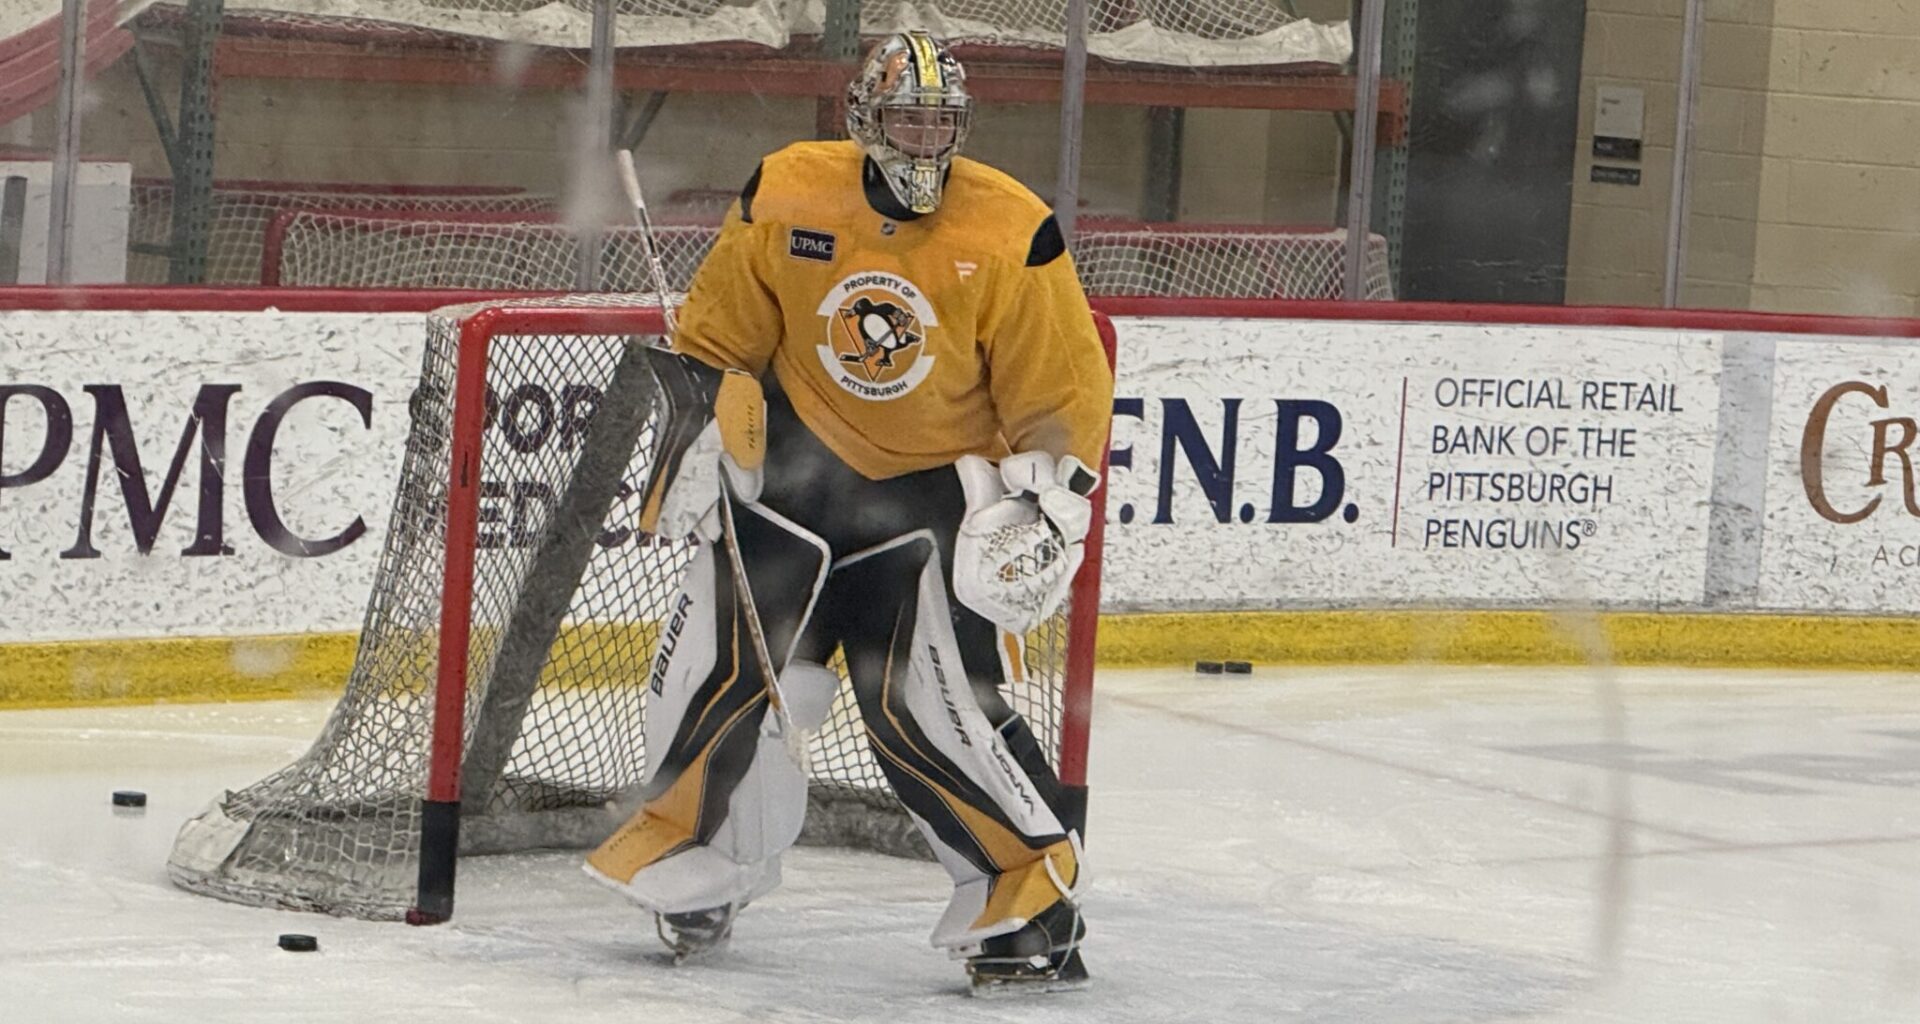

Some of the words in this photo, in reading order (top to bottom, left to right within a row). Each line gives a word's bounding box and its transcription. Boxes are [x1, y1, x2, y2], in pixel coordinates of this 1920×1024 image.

[792, 236, 833, 254] UPMC
[843, 276, 902, 293] PROPERTY
[901, 286, 917, 299] OF
[841, 375, 908, 397] PITTSBURGH
[1435, 377, 1572, 410] OFFICIAL
[1581, 380, 1684, 412] RETAIL
[1432, 424, 1516, 455] BANK
[1525, 425, 1569, 457] OF
[1577, 427, 1637, 458] THE
[1428, 471, 1613, 504] PITTSBURGH
[1899, 544, 1920, 567] C
[651, 593, 694, 698] BAUER
[928, 644, 973, 748] BAUER
[990, 736, 1034, 817] VAPOR
